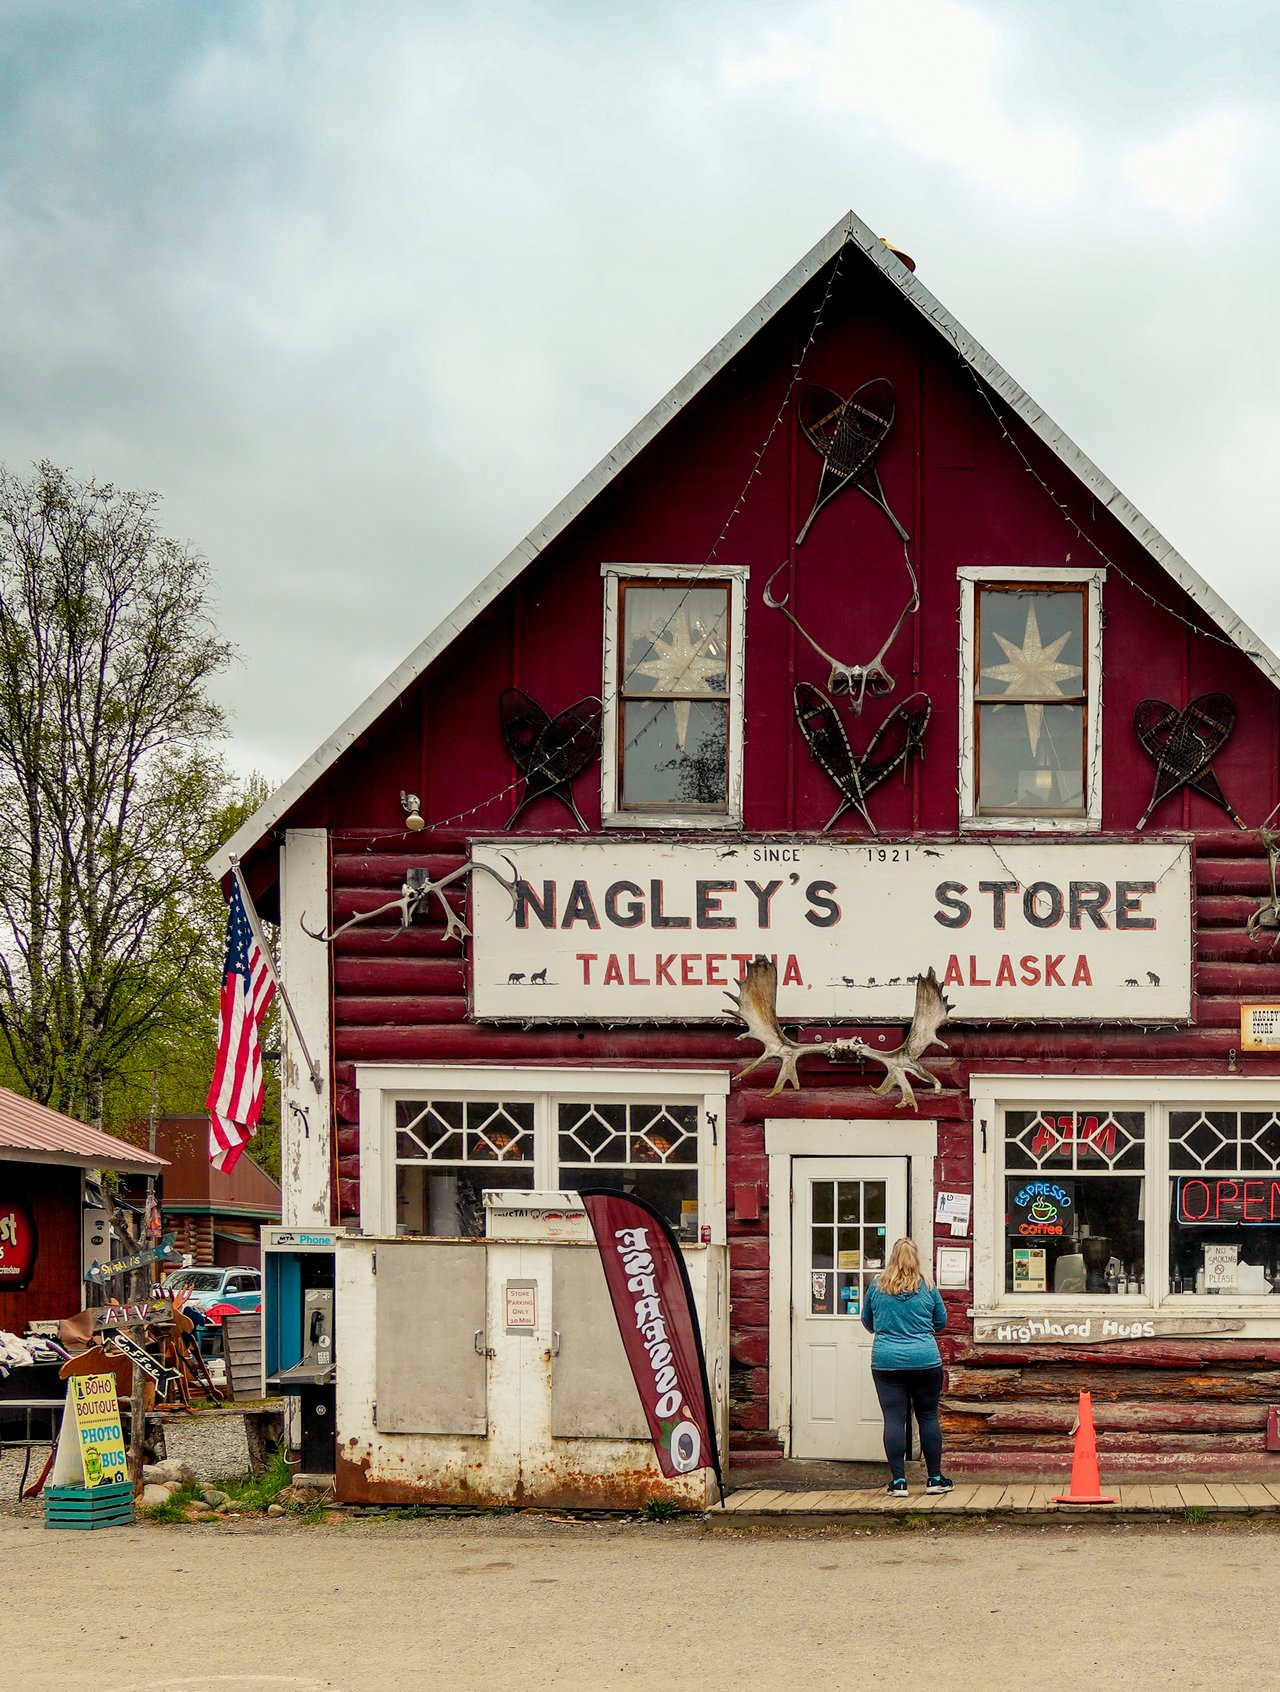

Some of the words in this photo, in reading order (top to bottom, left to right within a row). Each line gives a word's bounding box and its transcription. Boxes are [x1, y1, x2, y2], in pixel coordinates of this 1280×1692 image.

[753, 846, 800, 862] SINCE
[867, 849, 909, 862] 1921
[515, 872, 842, 930] NAGLEY'S
[933, 880, 1157, 930] STORE
[576, 953, 813, 990] TALKEETA,
[944, 954, 1093, 986] ALASKA
[1252, 1023, 1273, 1034] STORE
[1031, 1115, 1117, 1156] ATM
[1014, 1181, 1072, 1208] ESPRESSO
[1019, 1223, 1064, 1235] Coffee
[300, 1235, 331, 1245] Phone
[1208, 1255, 1237, 1264] SMOKING
[1215, 1247, 1226, 1255] NO
[1209, 1274, 1235, 1283] PLEASE
[105, 1303, 149, 1324] ATV
[997, 1318, 1091, 1343] Highland
[1101, 1319, 1156, 1338] Hugs
[114, 1334, 160, 1377] Coffee
[84, 1379, 112, 1396] BOHO
[81, 1424, 121, 1444] PHOTO
[101, 1450, 125, 1468] BUS
